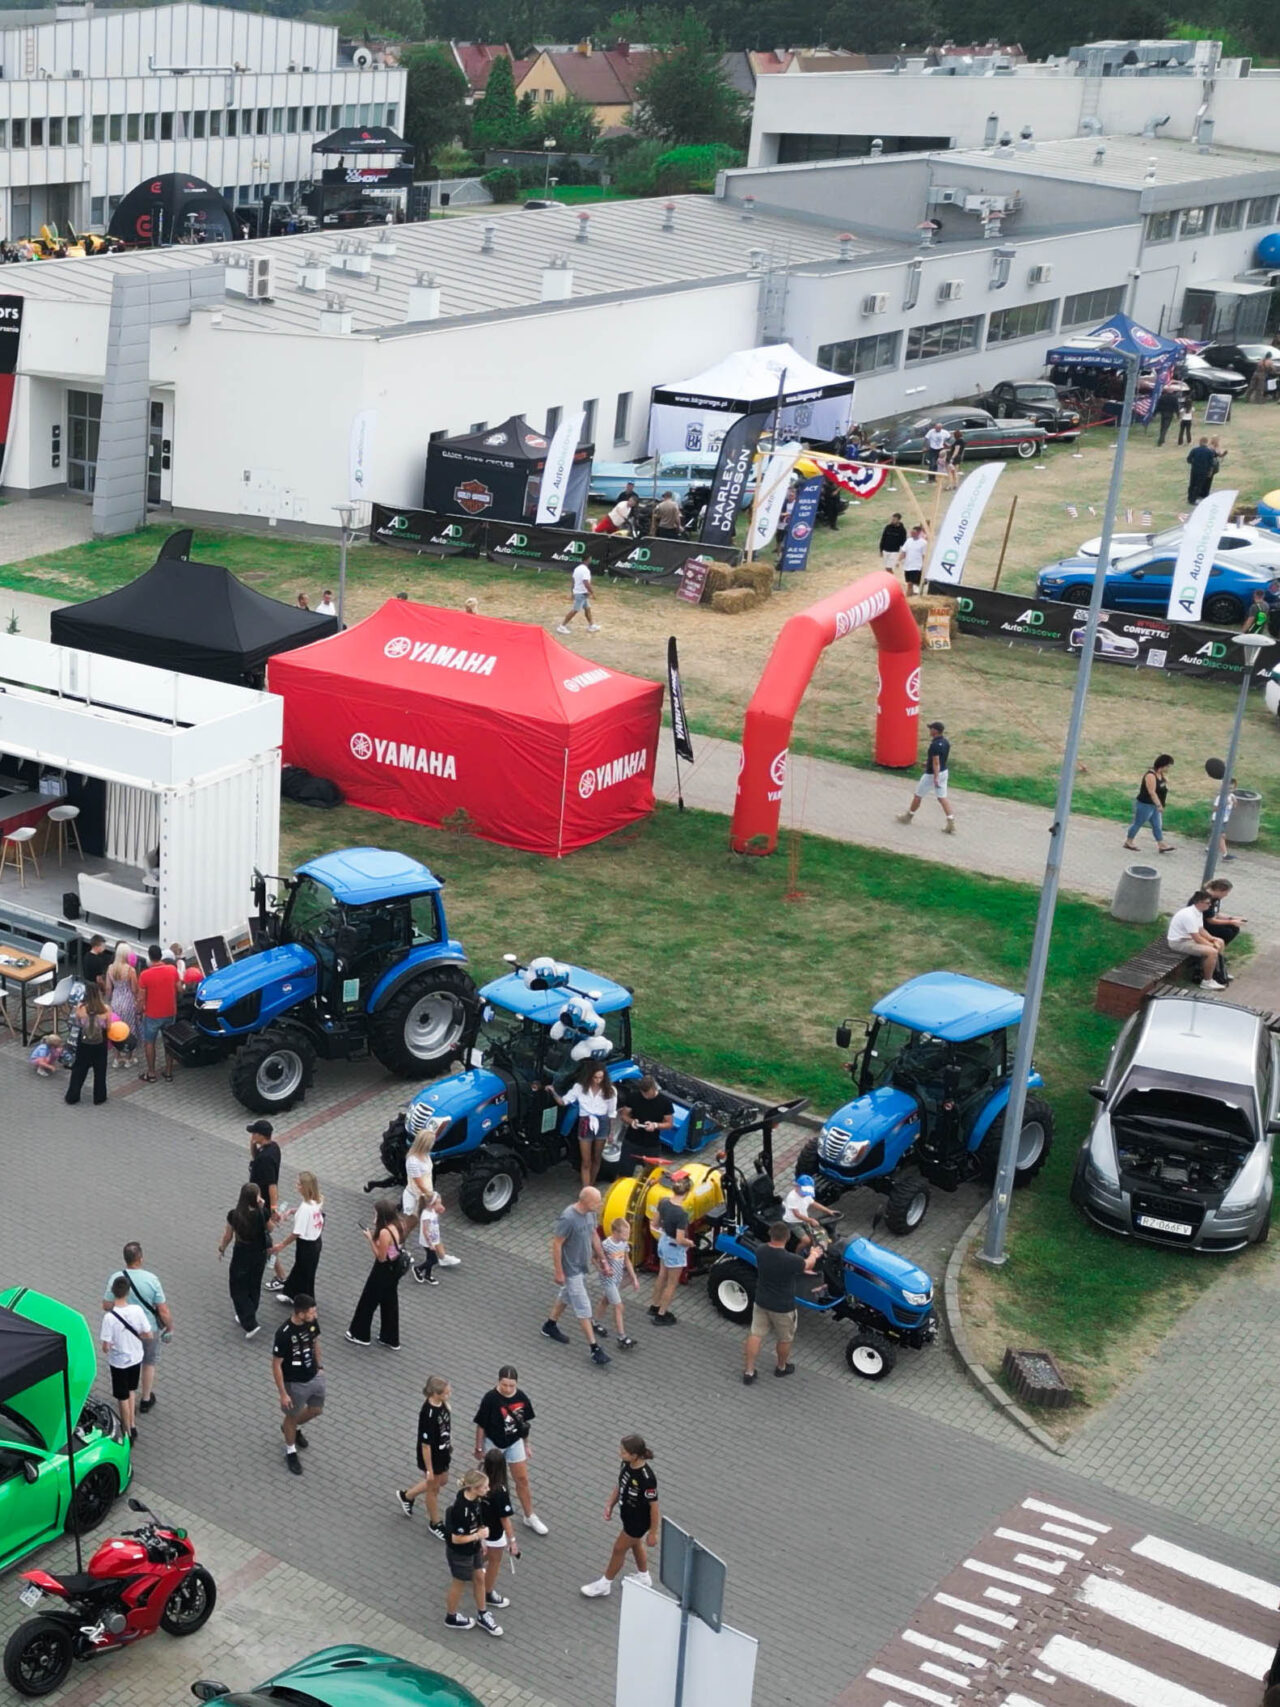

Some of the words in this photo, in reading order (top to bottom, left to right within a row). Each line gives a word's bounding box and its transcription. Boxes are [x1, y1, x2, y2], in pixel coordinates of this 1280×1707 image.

[711, 459, 735, 526] HARLEY
[721, 448, 751, 532] DAVIDSON
[387, 515, 409, 530] AD
[441, 523, 463, 538] AD
[505, 532, 528, 547] AD
[563, 540, 586, 554] AD
[494, 544, 542, 558] AutoDiscover
[627, 547, 651, 562] AD
[614, 560, 665, 573] AutoDiscover
[1016, 609, 1045, 626] AD
[1000, 622, 1062, 639] AutoDiscover
[1196, 640, 1227, 658] AD
[409, 641, 498, 676] YAMAHA
[1179, 653, 1245, 673] AutoDiscover
[571, 667, 613, 689] YAMAHA
[373, 737, 458, 780] YAMAHA
[595, 747, 647, 791] YAMAHA
